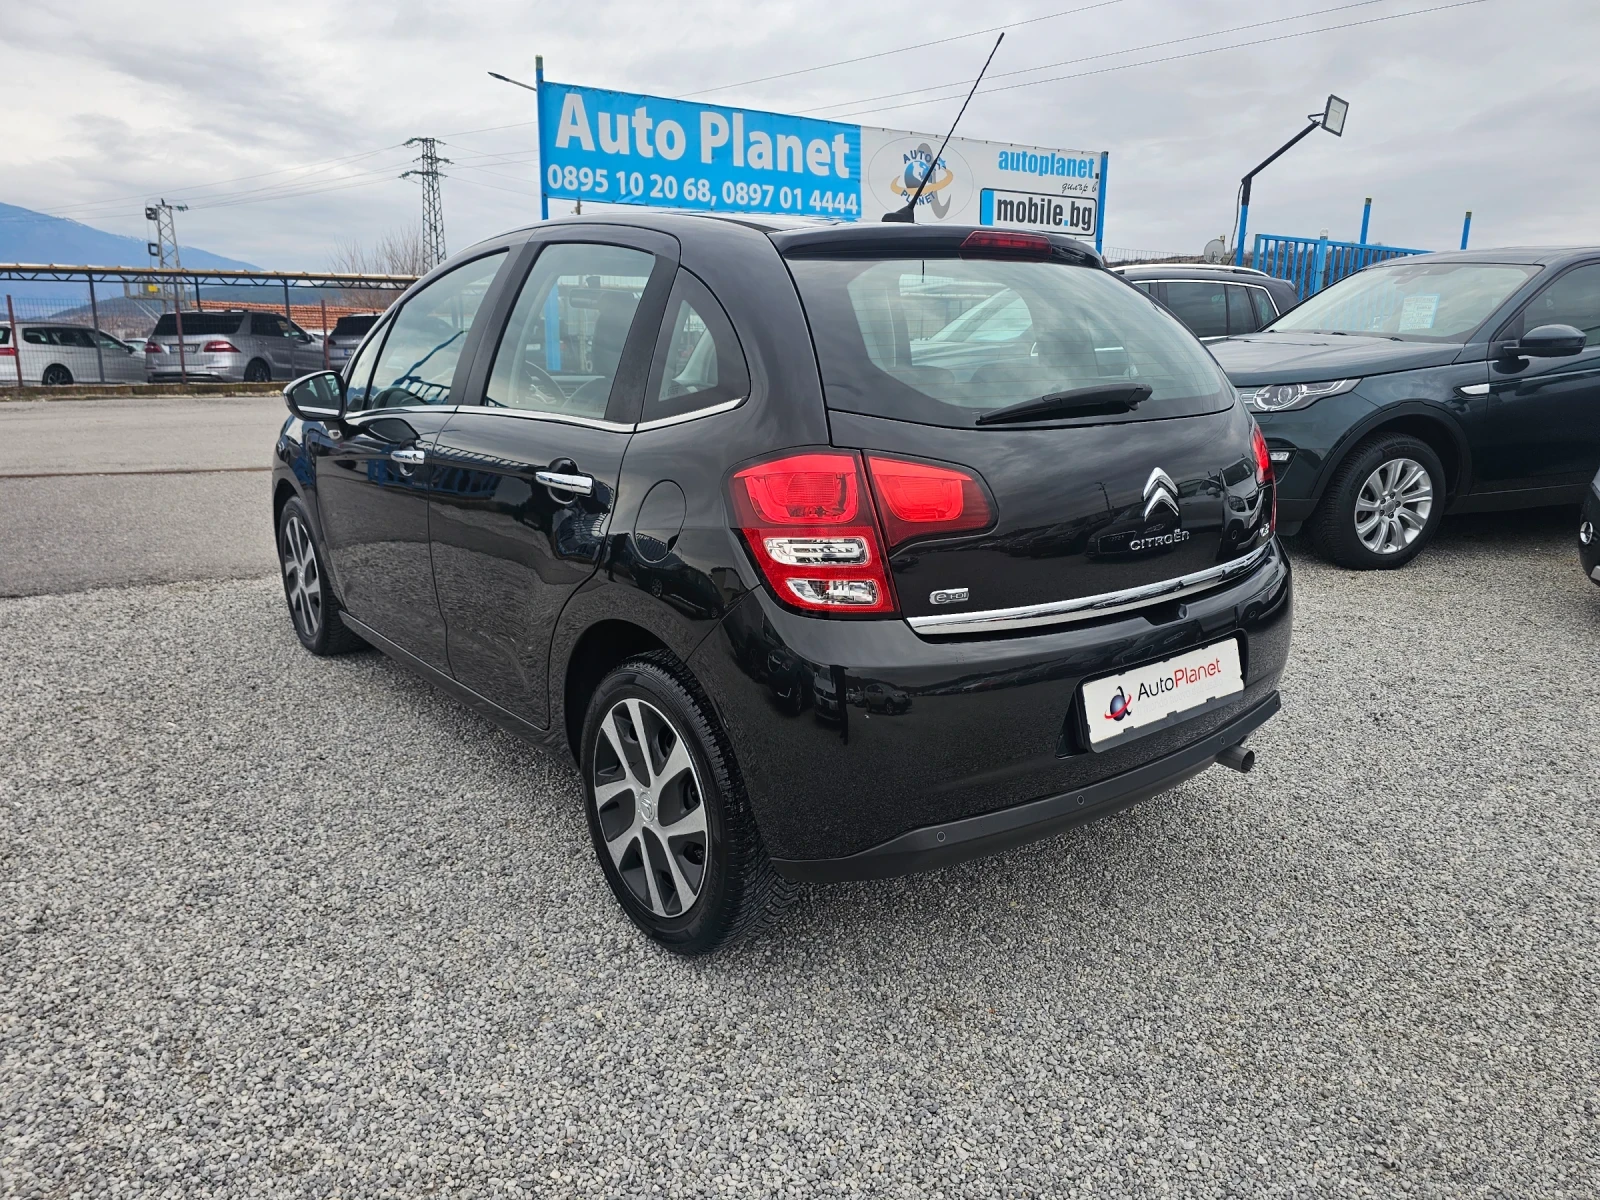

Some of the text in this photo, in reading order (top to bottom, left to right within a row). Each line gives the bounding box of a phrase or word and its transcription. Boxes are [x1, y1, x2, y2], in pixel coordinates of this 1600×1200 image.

[555, 93, 849, 178] Auto Planet
[903, 150, 932, 164] AUTO
[548, 164, 858, 215] 0895 10 20 68, 0897 01 4444
[997, 196, 1092, 231] mobile.bg
[1137, 657, 1222, 702] AutoPlanet
